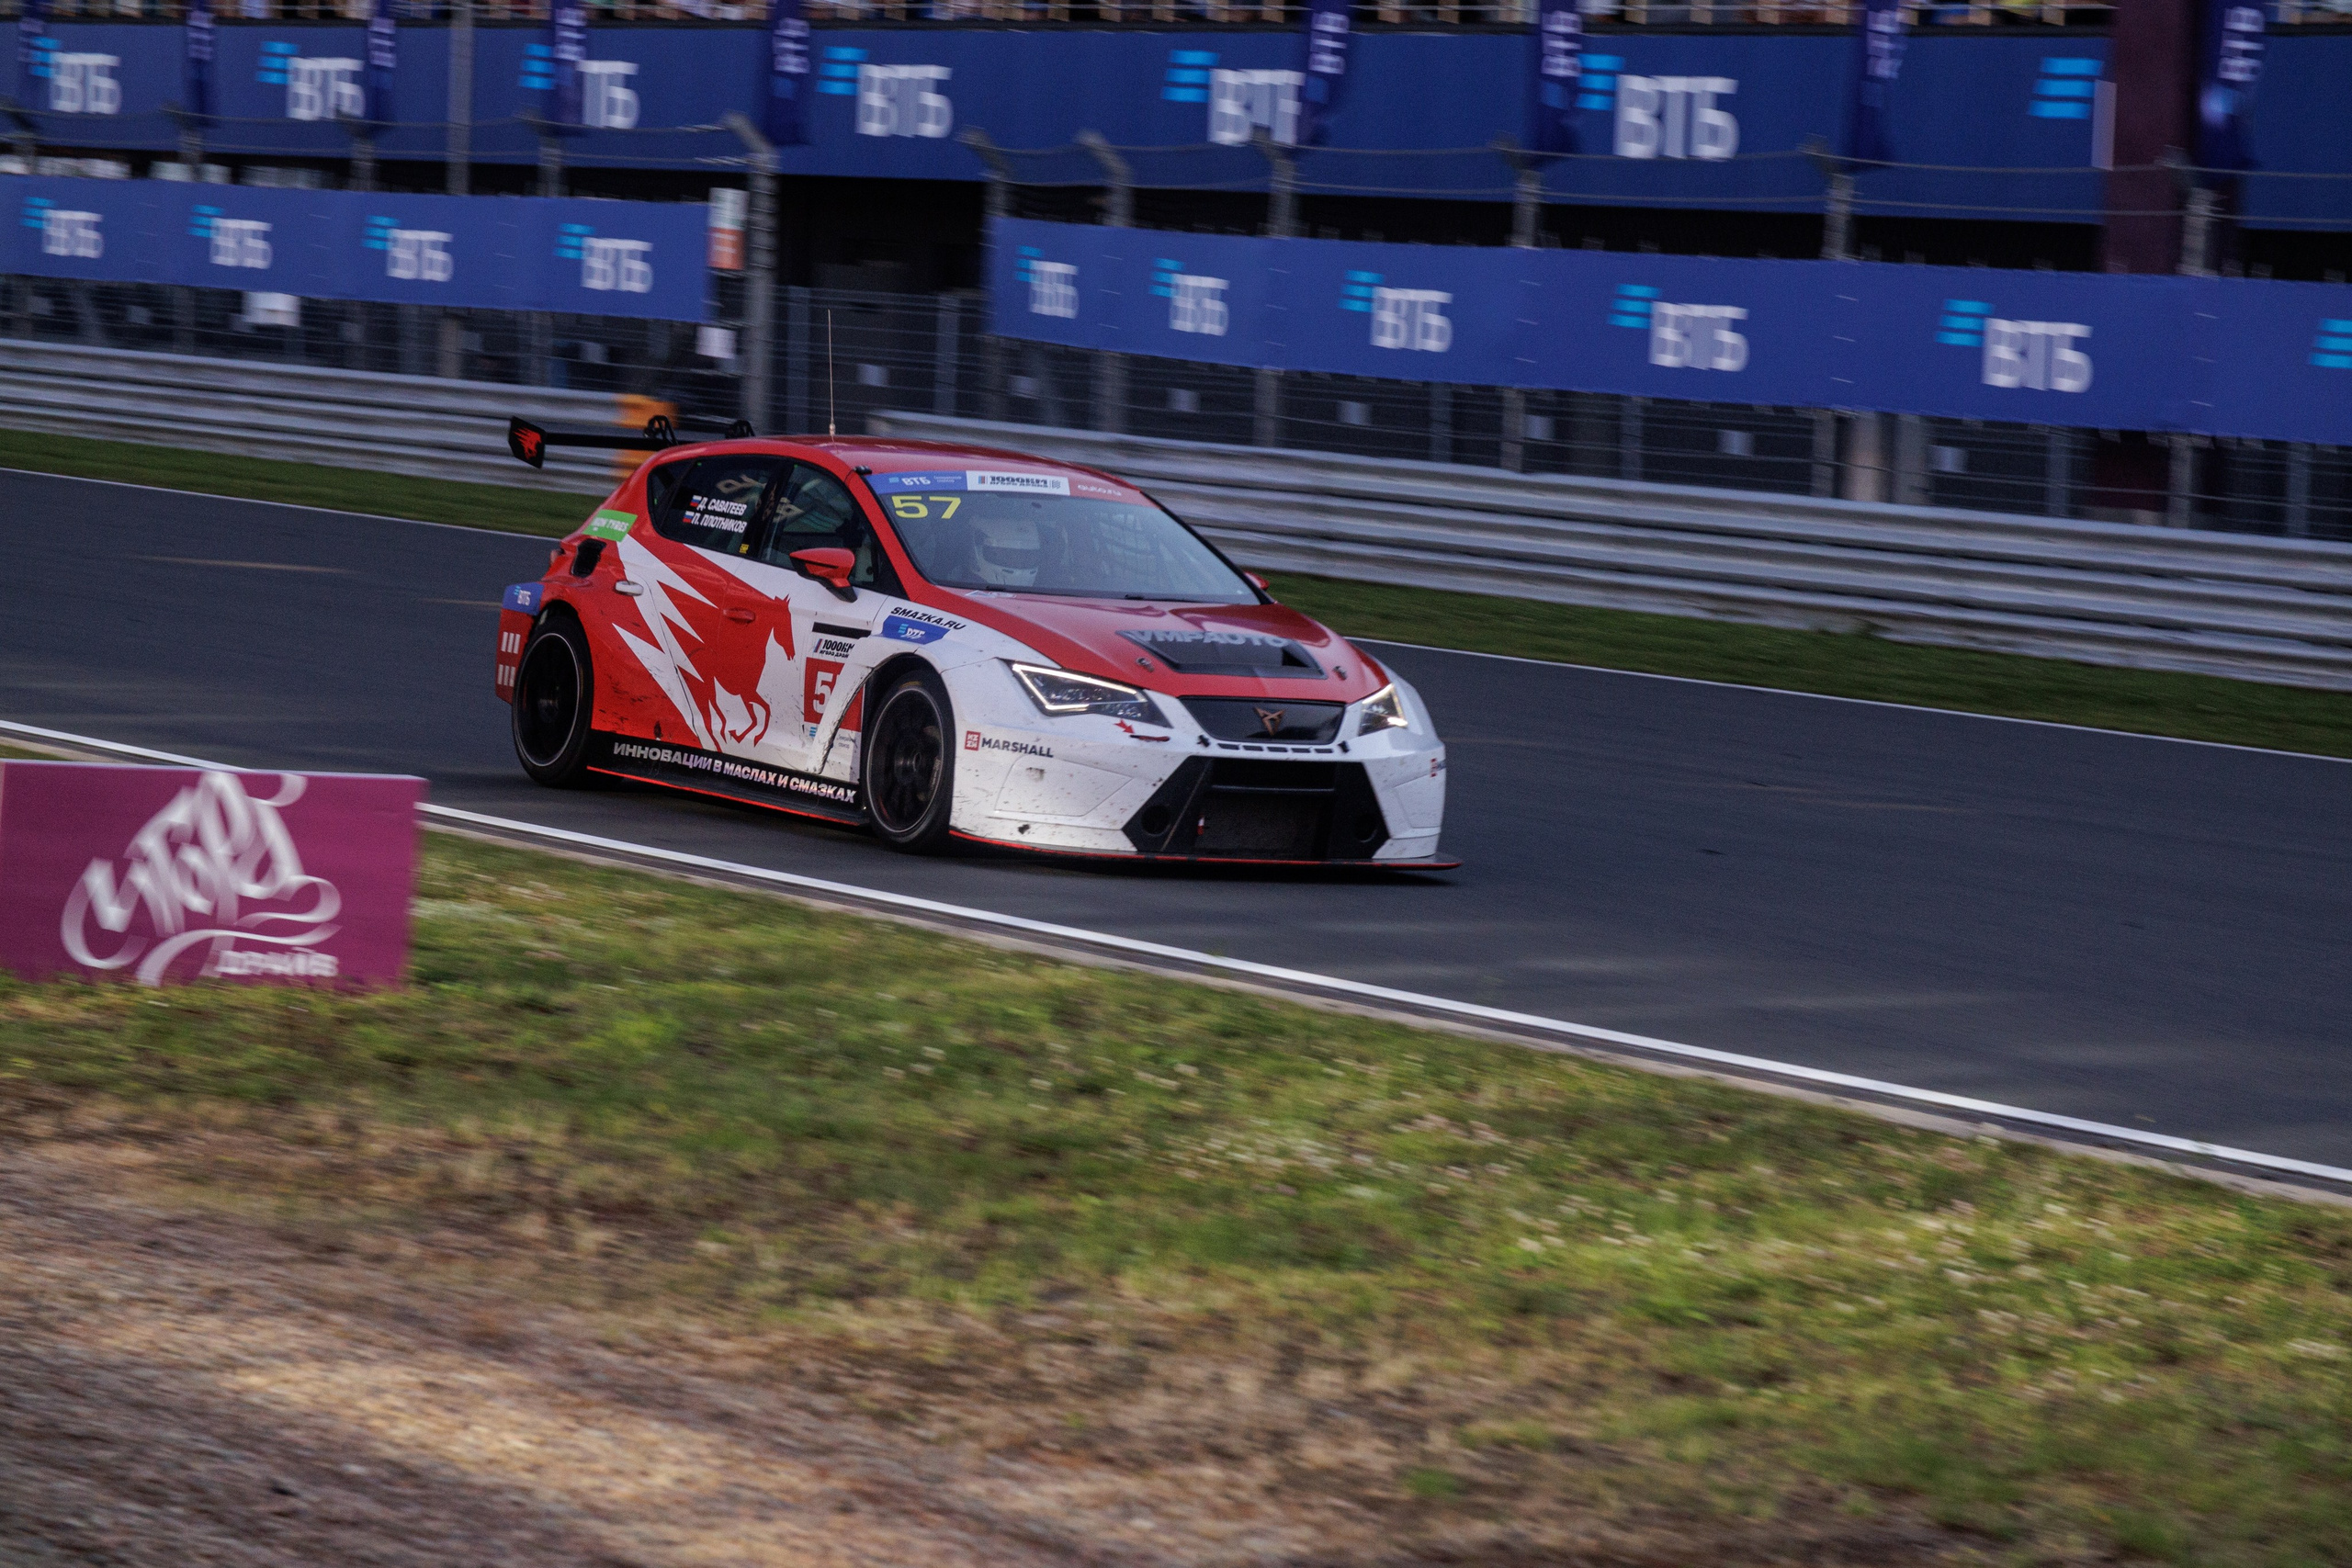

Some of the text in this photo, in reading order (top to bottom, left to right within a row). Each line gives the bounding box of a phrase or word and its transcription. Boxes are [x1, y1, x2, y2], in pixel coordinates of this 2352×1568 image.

[575, 61, 640, 129] ТБ
[856, 63, 955, 138] ВТБ
[1612, 73, 1739, 161] ВТБ
[1982, 318, 2094, 393] ВТБ
[700, 513, 747, 533] ПЛОТНИКОВ
[707, 499, 747, 516] САВАТЕЕВ
[891, 495, 962, 519] 57
[890, 606, 967, 630] SMAZKA.RU
[812, 671, 840, 715] 5
[981, 738, 1054, 758] MARSHALL
[614, 742, 856, 804] ИННОВАЦИИ В МАСЛАХ И СМАЗКАХ
